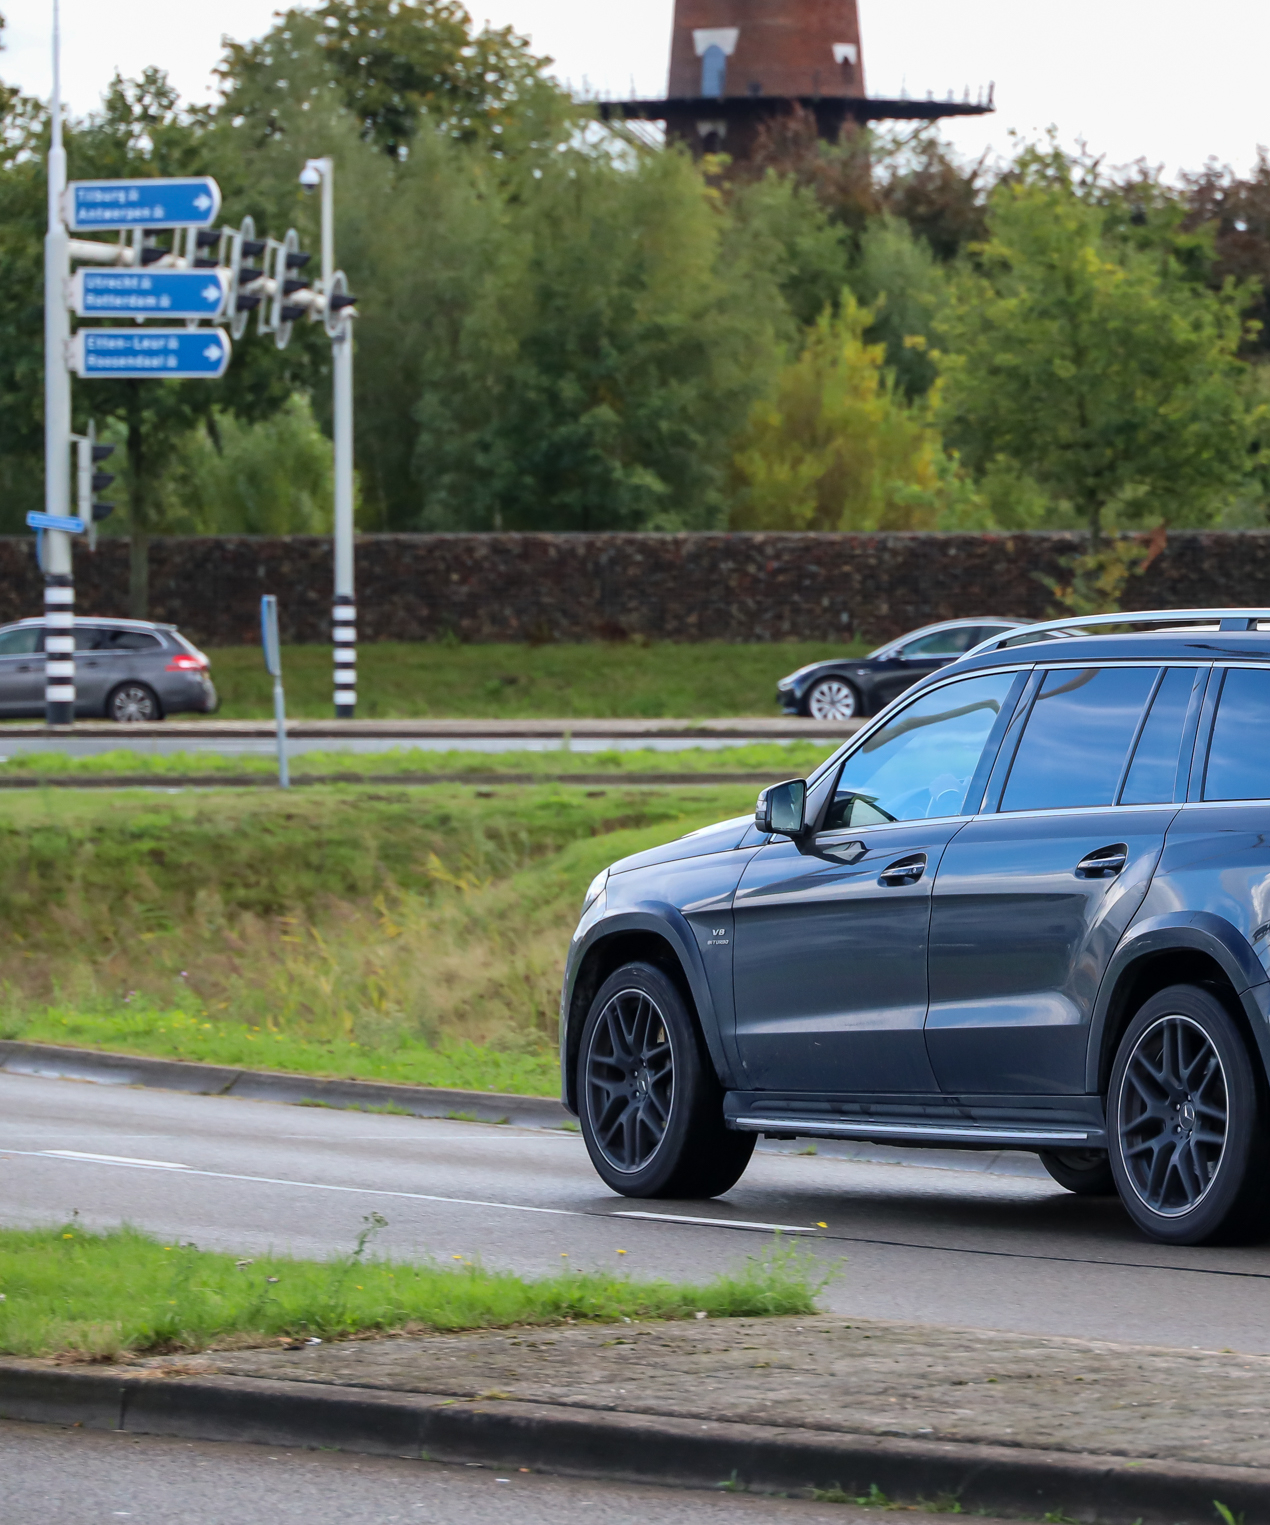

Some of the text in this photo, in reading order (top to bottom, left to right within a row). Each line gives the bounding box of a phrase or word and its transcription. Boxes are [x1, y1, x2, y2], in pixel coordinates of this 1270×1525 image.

[77, 188, 126, 204] Tilburg
[78, 207, 150, 221] Antwerpen
[86, 276, 139, 289] Utrecht
[86, 293, 157, 308] Rotterdam
[87, 336, 166, 350] Etten-Leur
[87, 354, 166, 367] Roosendaal
[712, 928, 726, 936] V8
